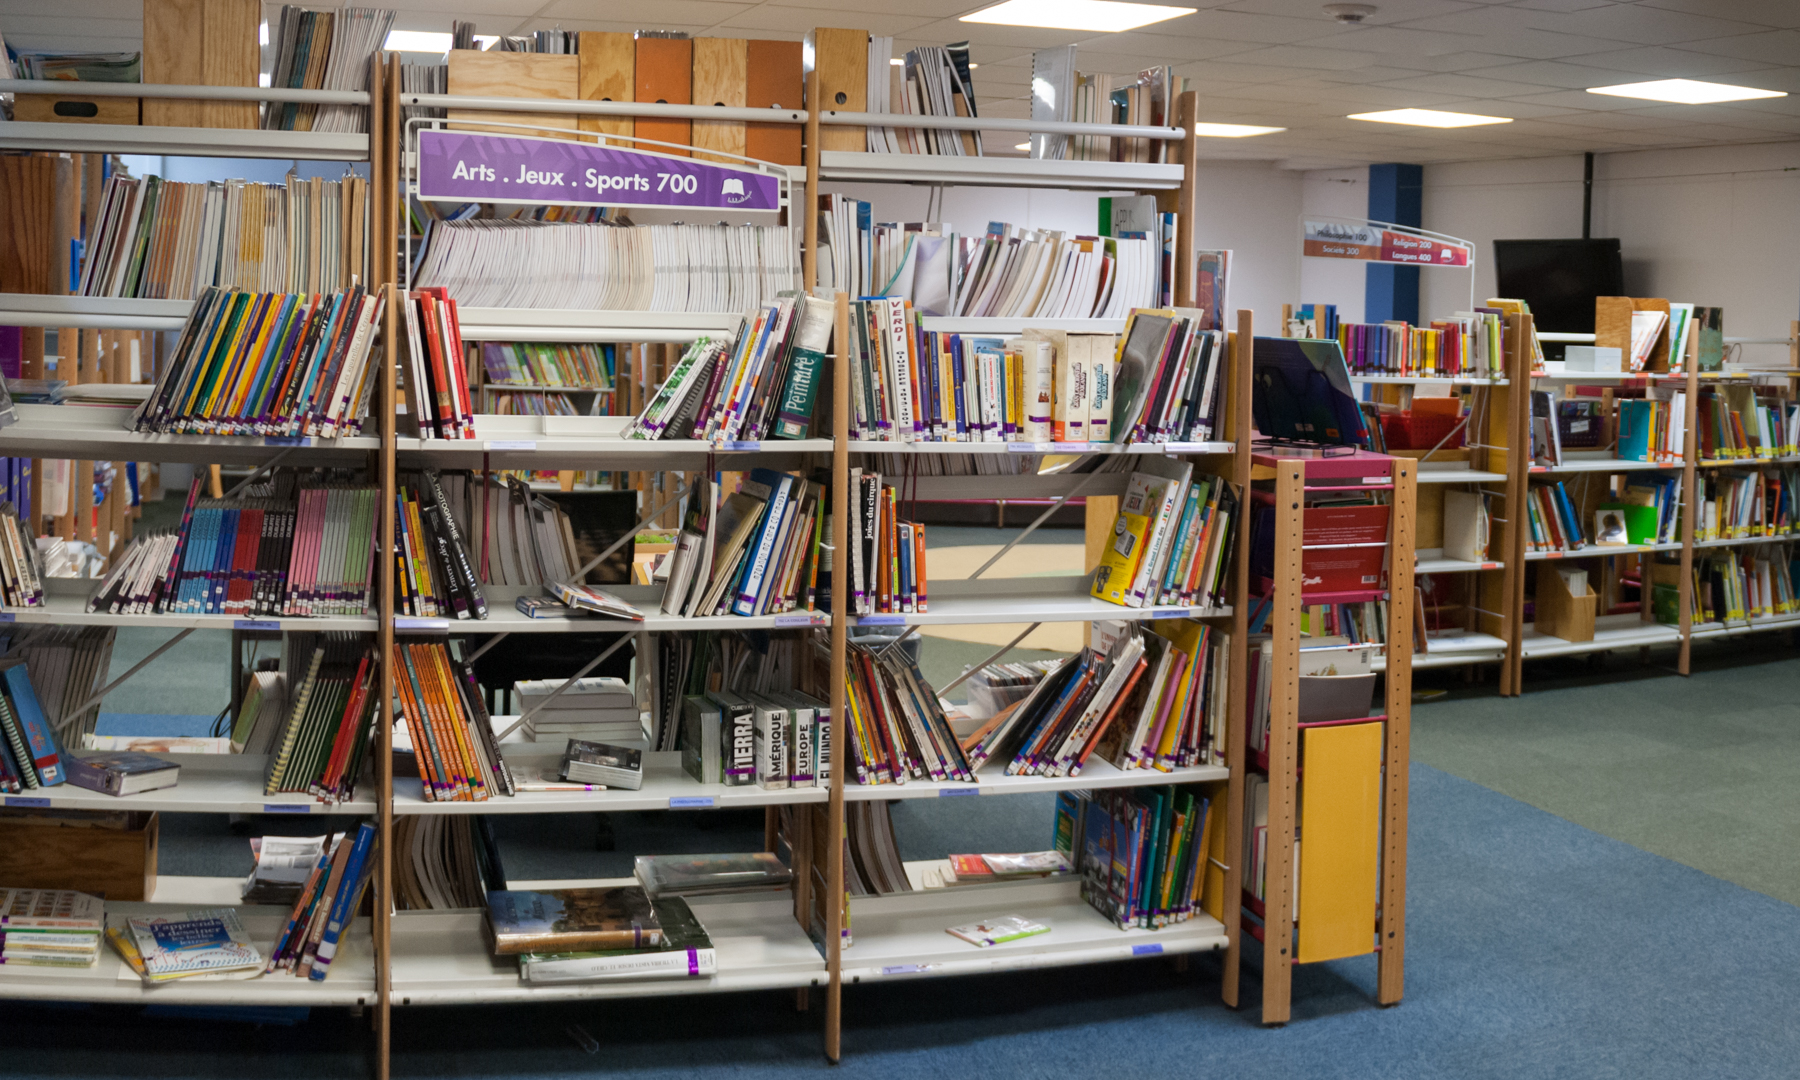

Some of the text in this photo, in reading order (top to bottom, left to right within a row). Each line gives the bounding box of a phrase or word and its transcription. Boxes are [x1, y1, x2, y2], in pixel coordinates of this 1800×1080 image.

[452, 160, 496, 182] Arts
[516, 164, 565, 186] Jeux
[585, 168, 650, 194] Sports
[656, 173, 698, 194] 700
[1317, 229, 1368, 242] Philosophie 100
[1393, 238, 1432, 250] Religion 200
[1323, 245, 1359, 255] Société 300
[1392, 251, 1431, 262] Langues 400
[346, 340, 358, 374] aquarelles
[357, 329, 362, 341] de
[360, 305, 374, 330] Cézanne
[891, 301, 907, 386] VERDI GIUSEPPE
[787, 357, 815, 412] Peinture
[431, 472, 460, 540] LA PHOTOGRAPHIE
[865, 477, 876, 540] joies du cirque
[1162, 498, 1174, 524] JEUX
[1152, 536, 1162, 551] Livre
[1146, 550, 1157, 567] Grand
[446, 563, 459, 593] L'envers
[1144, 567, 1151, 575] Le
[402, 701, 411, 719] enfants
[410, 702, 419, 720] enfants
[417, 697, 426, 715] enfants
[426, 702, 435, 720] enfants
[433, 702, 442, 720] enfants
[439, 702, 449, 720] enfants
[454, 702, 463, 720] enfants
[733, 713, 755, 770] TIERRA
[769, 713, 782, 779] AMÉRIQUE
[799, 724, 809, 775] EUROPE
[414, 749, 422, 762] Terre
[423, 750, 431, 763] Terre
[446, 750, 454, 763] Terre
[453, 749, 461, 763] Terre
[468, 749, 476, 763] Terre
[820, 726, 831, 779] EL MUNDO
[497, 754, 511, 784] PHOTOGRAPHIE
[152, 919, 222, 932] J'apprends
[158, 926, 221, 938] à dessiner
[185, 932, 214, 941] belles
[650, 958, 668, 967] TIERRA
